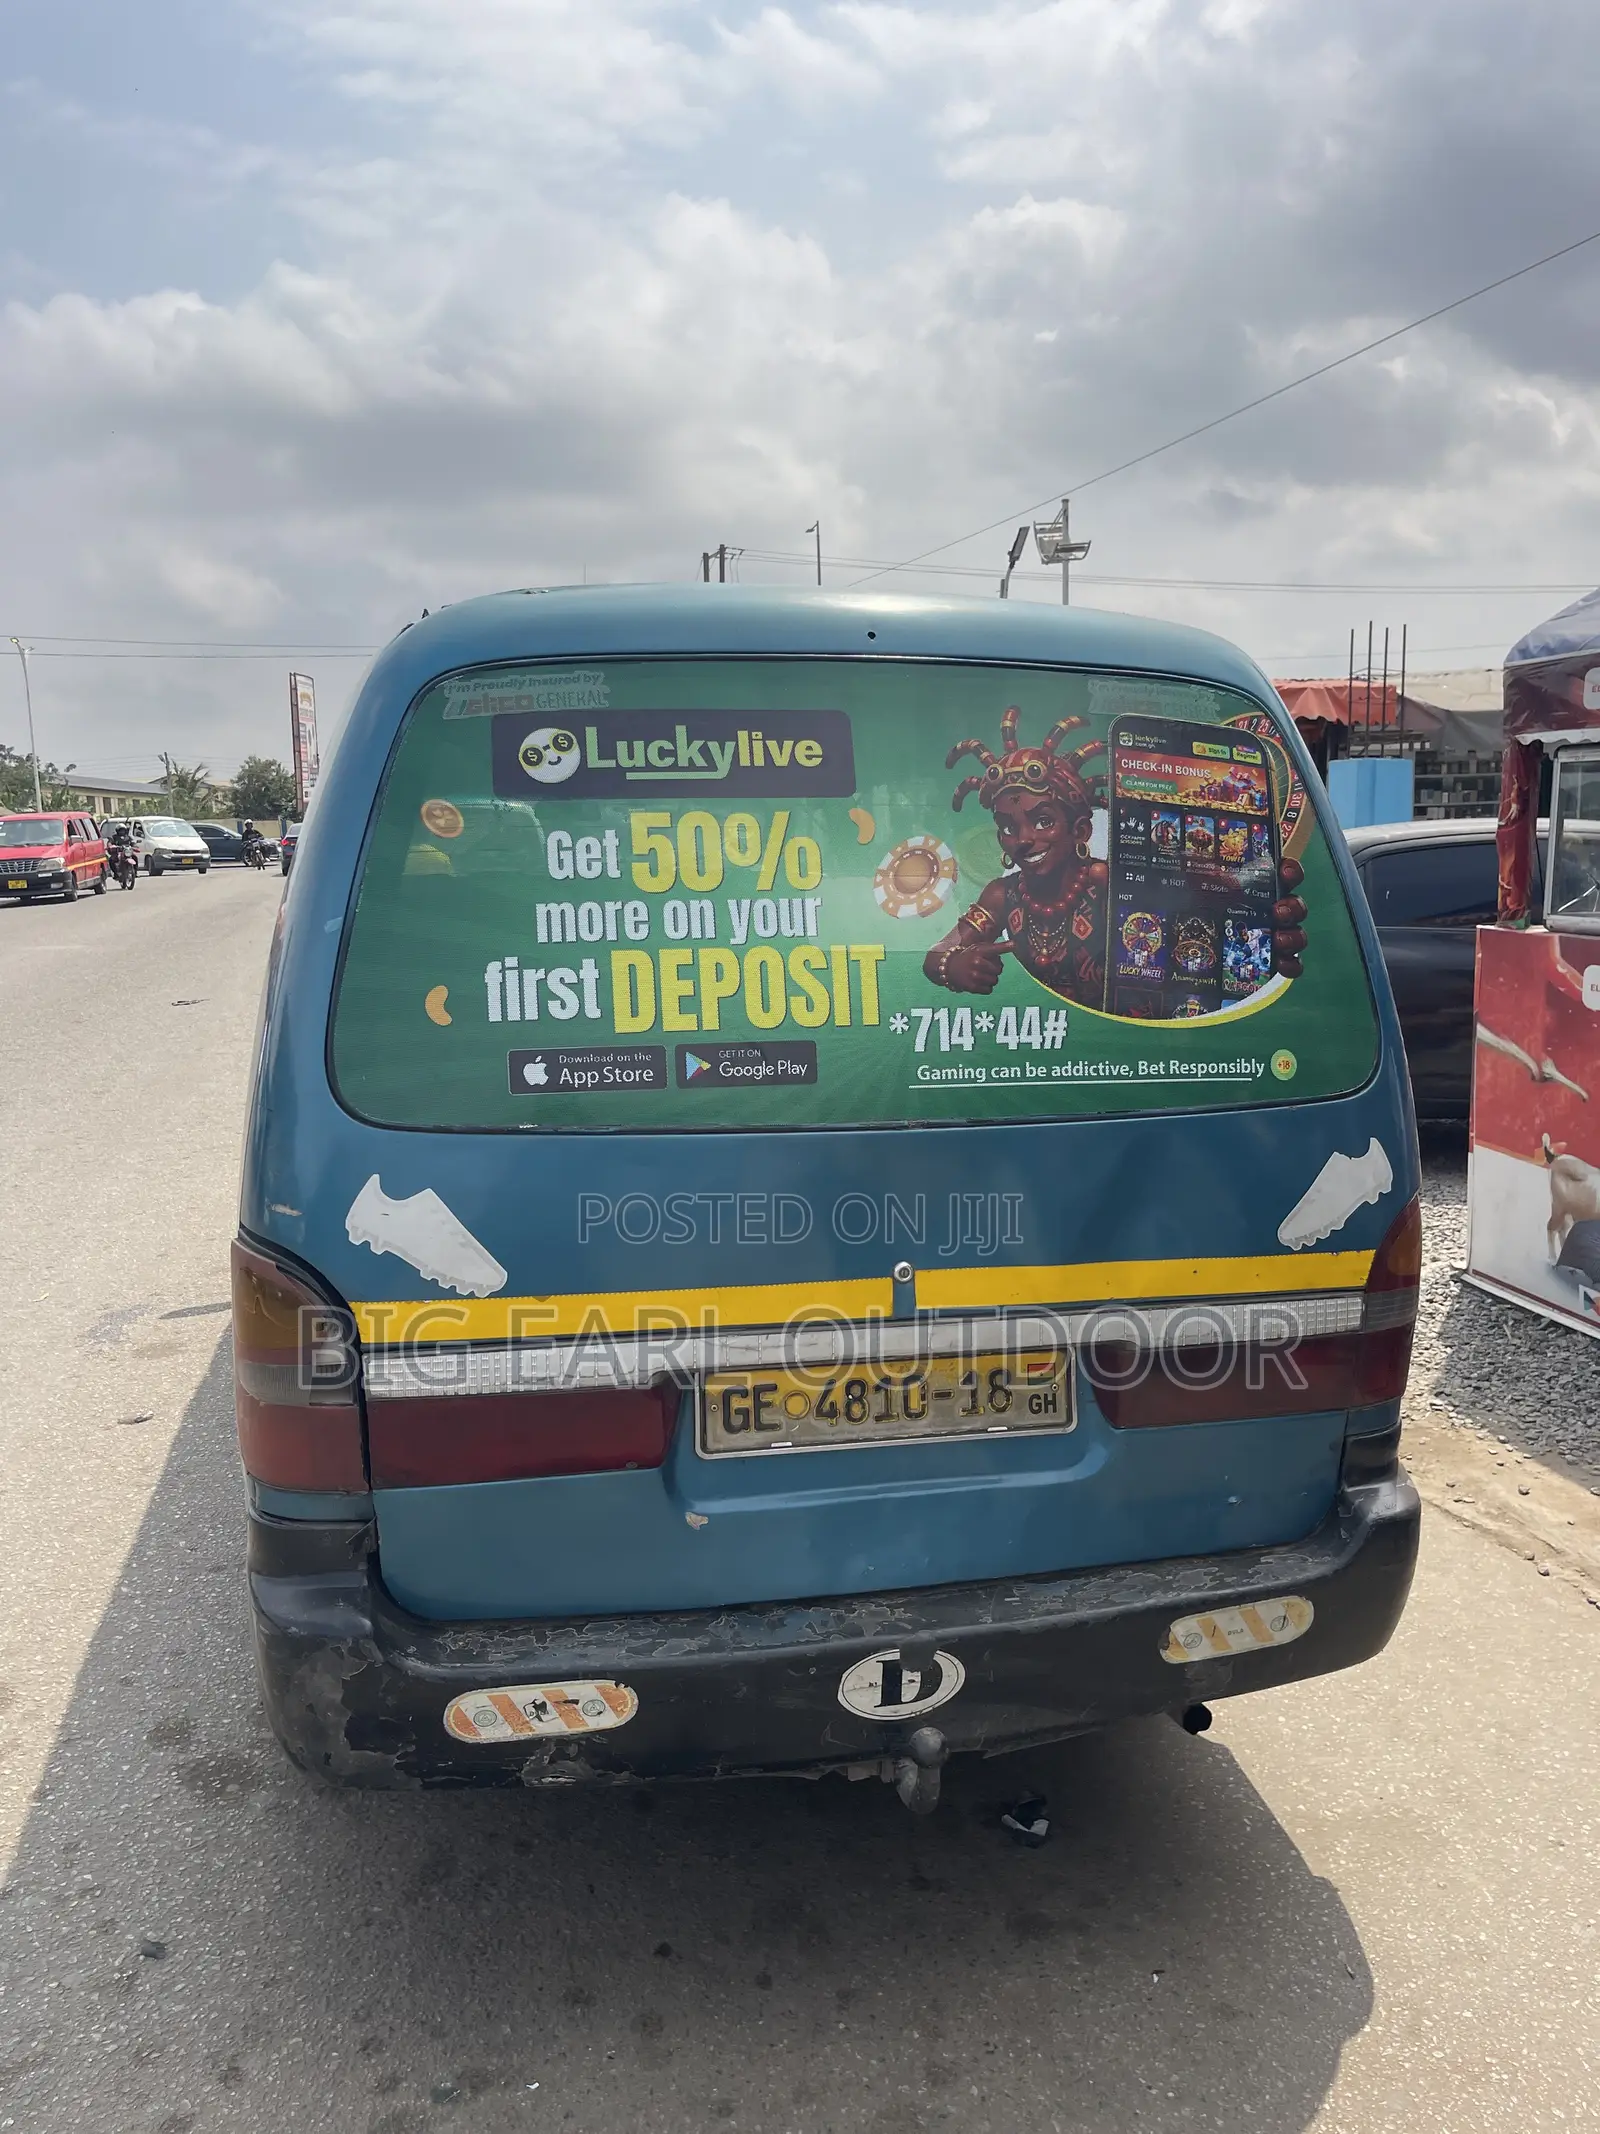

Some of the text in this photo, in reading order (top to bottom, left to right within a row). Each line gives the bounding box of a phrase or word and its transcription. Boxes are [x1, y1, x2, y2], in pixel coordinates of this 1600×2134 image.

[585, 725, 823, 780] Luckylive
[1121, 758, 1211, 779] CHECK-IN BONUS
[547, 811, 823, 893] Get 50%
[535, 897, 822, 945] more on your
[1119, 964, 1163, 978] LUCKY WHEEL
[484, 944, 885, 1034] first DEPOSIT
[559, 1052, 652, 1064] Download on the
[718, 1049, 761, 1059] GET IT ON
[1277, 1060, 1291, 1070] +18
[559, 1066, 654, 1088] App Store
[719, 1059, 807, 1080] Google Play
[917, 1058, 1265, 1082] Gaming can be addictive, Bet Responsibly
[721, 1383, 782, 1434] GE
[1028, 1393, 1058, 1415] GH
